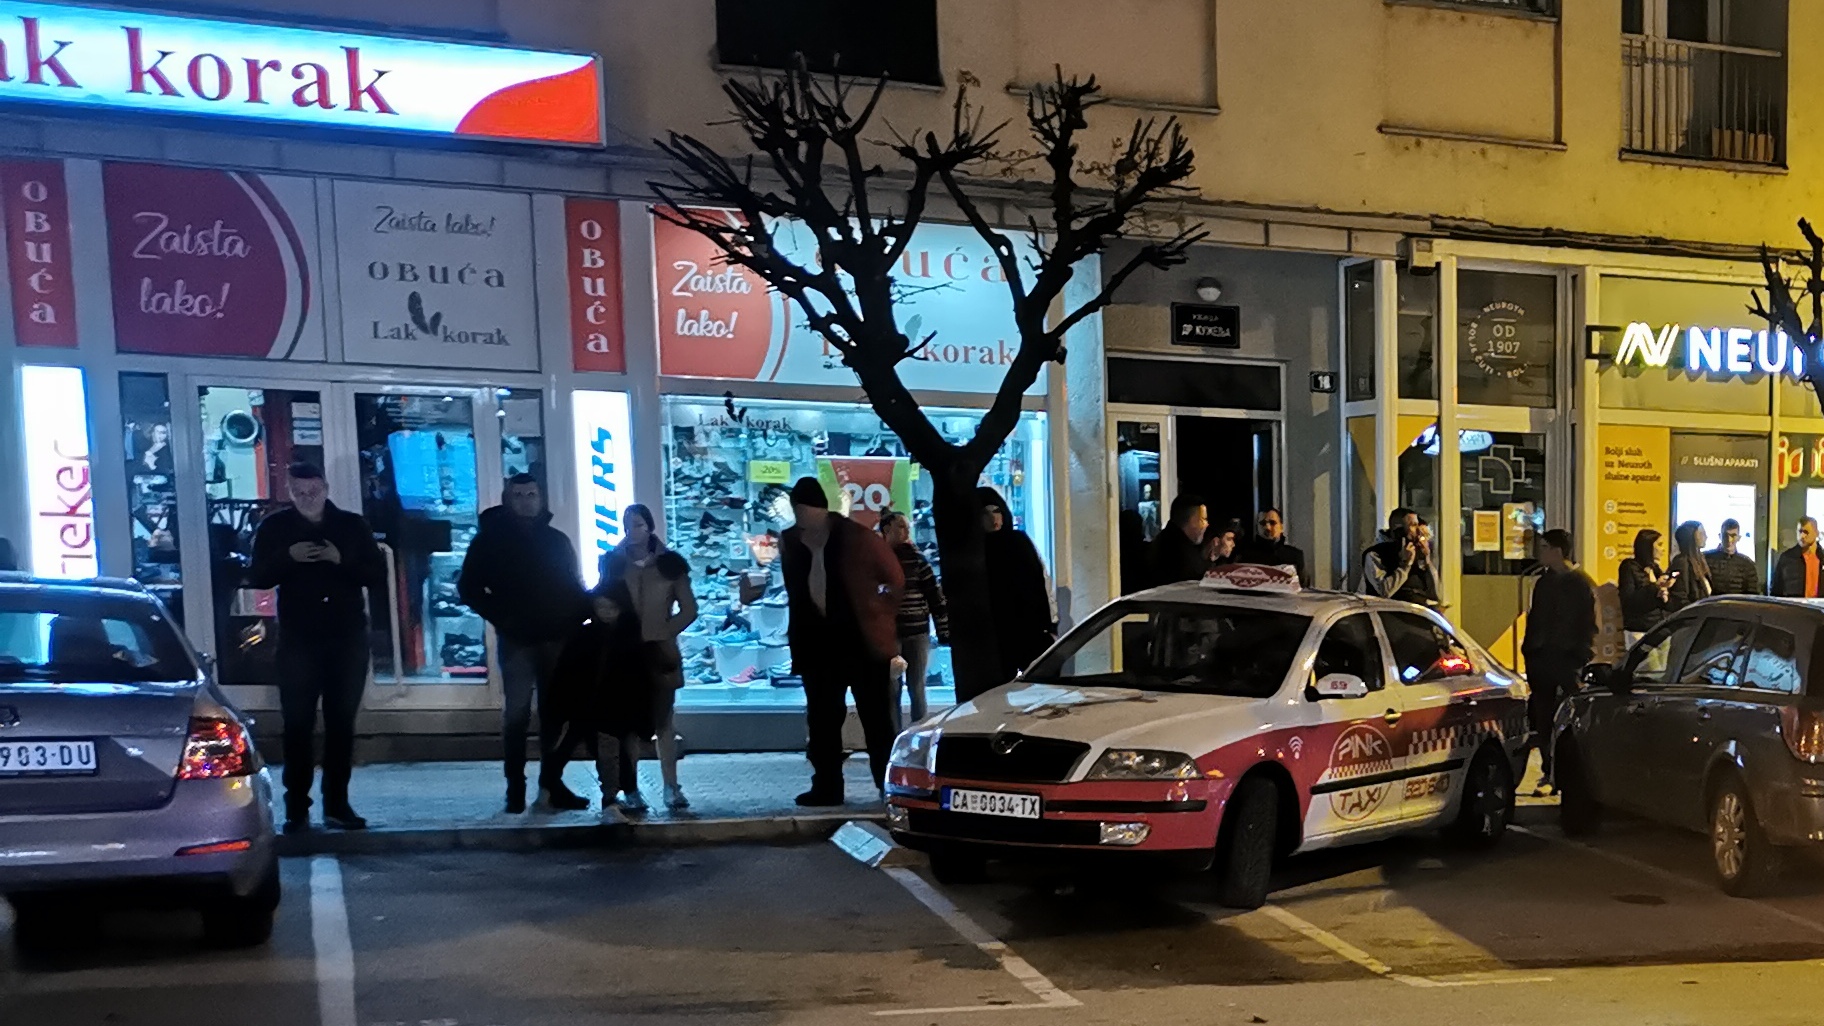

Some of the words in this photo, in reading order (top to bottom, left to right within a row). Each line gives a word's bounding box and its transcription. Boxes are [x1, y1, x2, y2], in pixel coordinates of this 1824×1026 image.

[120, 25, 400, 116] korak
[374, 205, 437, 234] Zaista
[131, 211, 251, 260] Zaista
[672, 260, 752, 298] Zaista
[140, 276, 231, 319] lako!
[372, 320, 417, 341] Lak
[442, 324, 510, 346] korak
[675, 308, 738, 339] lako!
[1492, 324, 1516, 338] OD
[920, 335, 1016, 367] korak
[1487, 340, 1520, 353] 1907
[746, 418, 792, 431] korak
[1724, 458, 1759, 469] APARATI
[39, 439, 93, 575] ieker
[842, 483, 891, 512] 20
[1338, 733, 1383, 761] PINK
[952, 791, 968, 810] CA
[1338, 786, 1382, 814] TAXI
